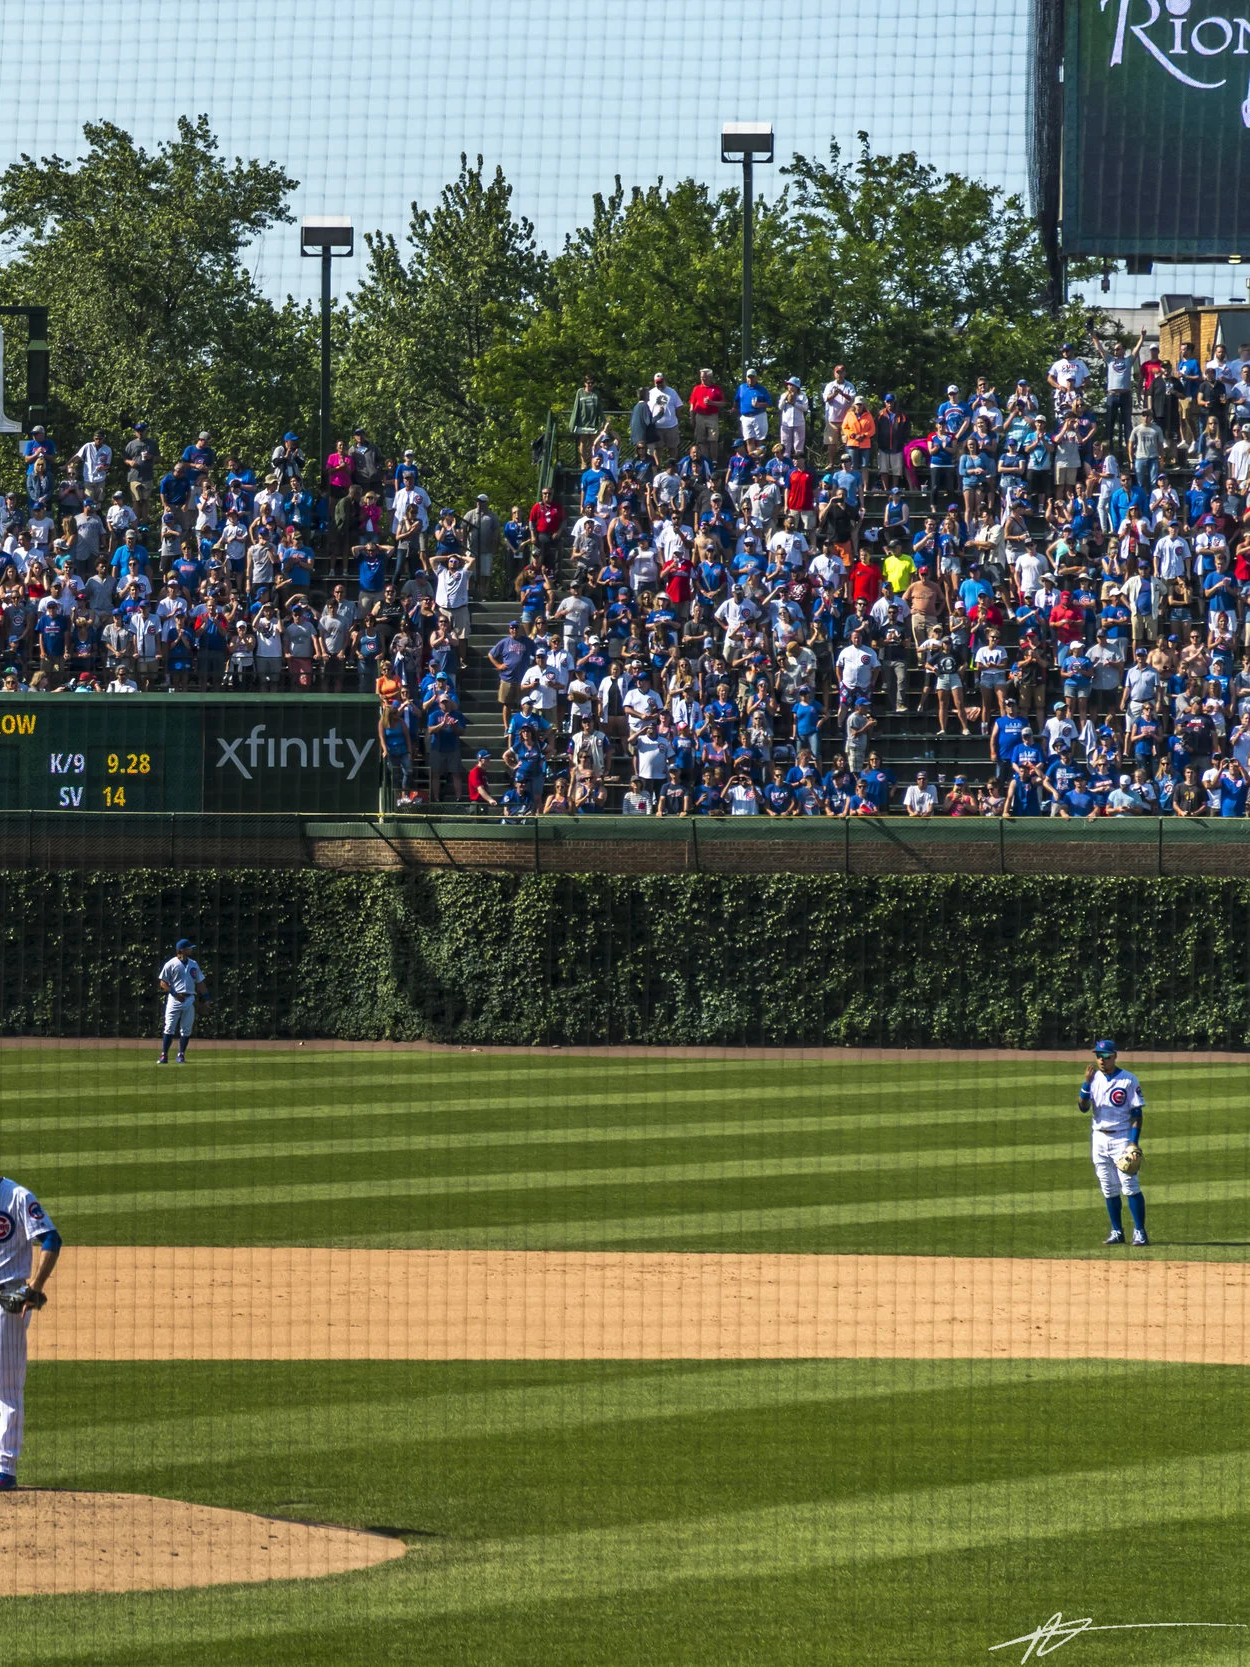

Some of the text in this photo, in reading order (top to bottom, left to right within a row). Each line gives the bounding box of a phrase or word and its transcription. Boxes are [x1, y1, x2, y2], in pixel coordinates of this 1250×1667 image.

[215, 724, 376, 780] xfinity
[50, 753, 86, 774] K/9
[107, 753, 151, 774] 9.28
[59, 786, 84, 807] SV
[102, 786, 126, 807] 14
